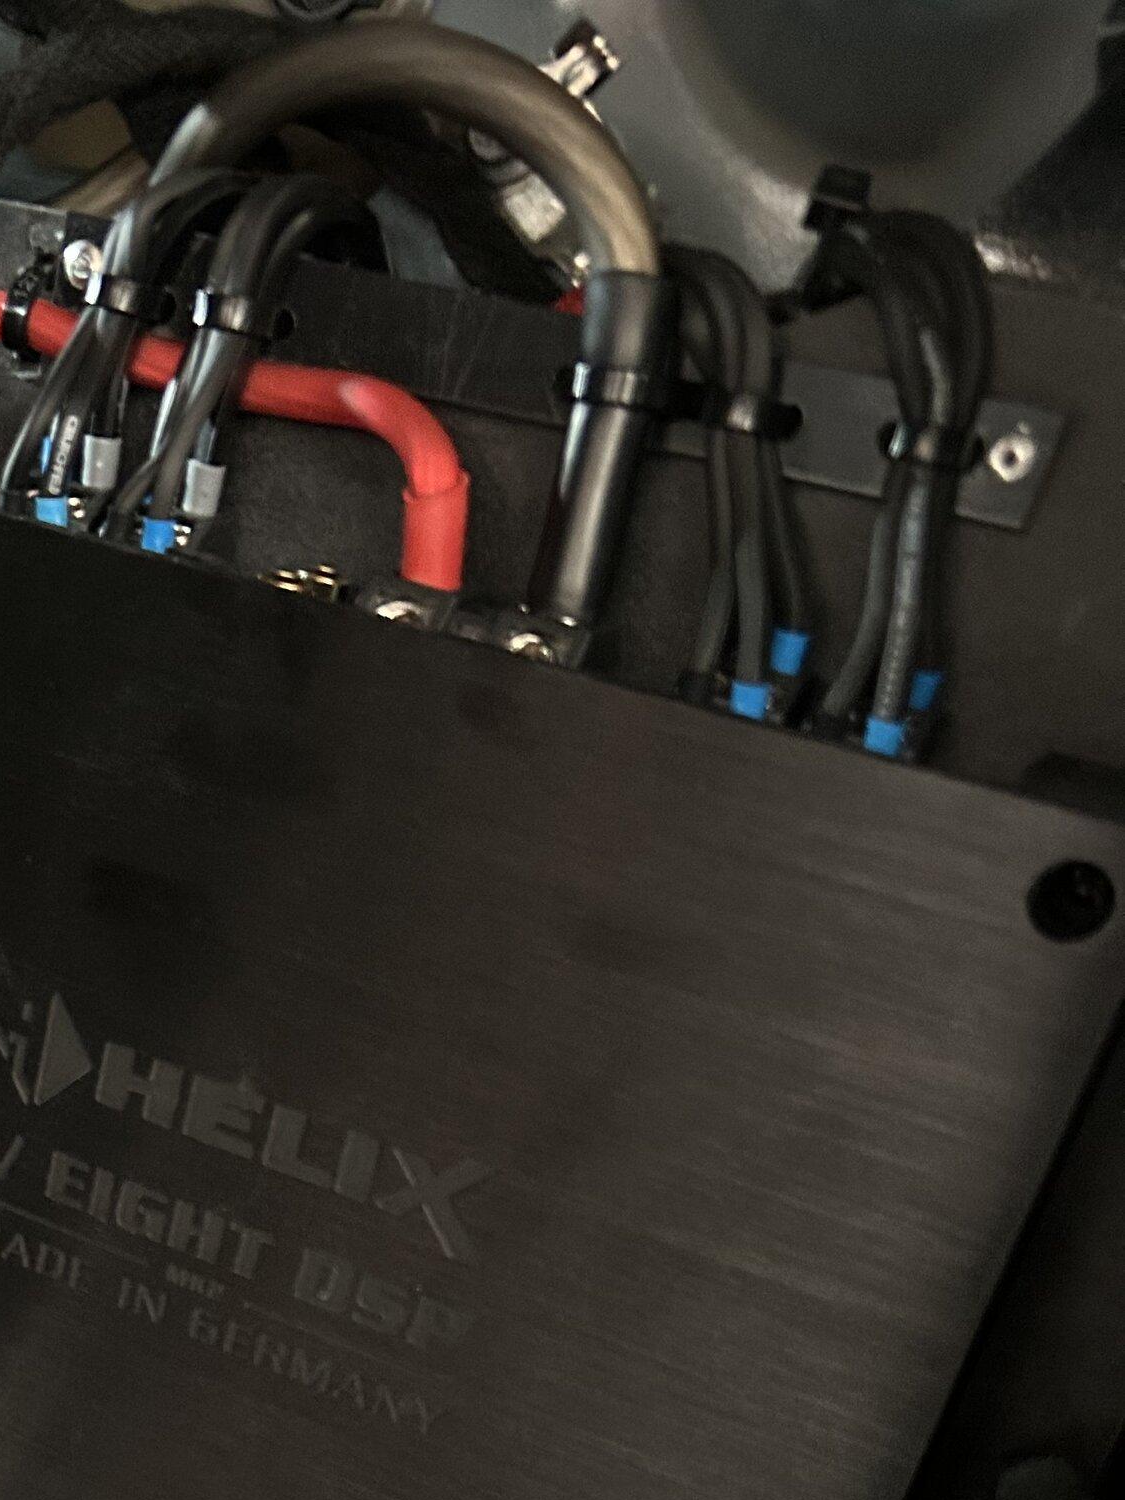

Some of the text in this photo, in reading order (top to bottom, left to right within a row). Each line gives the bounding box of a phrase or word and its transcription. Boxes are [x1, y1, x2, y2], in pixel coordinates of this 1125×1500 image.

[45, 1150, 275, 1281] EIGHT
[293, 1245, 480, 1349] DSP
[93, 1041, 499, 1264] HELIX
[116, 1276, 168, 1325] IN
[187, 1306, 447, 1436] GERMANY
